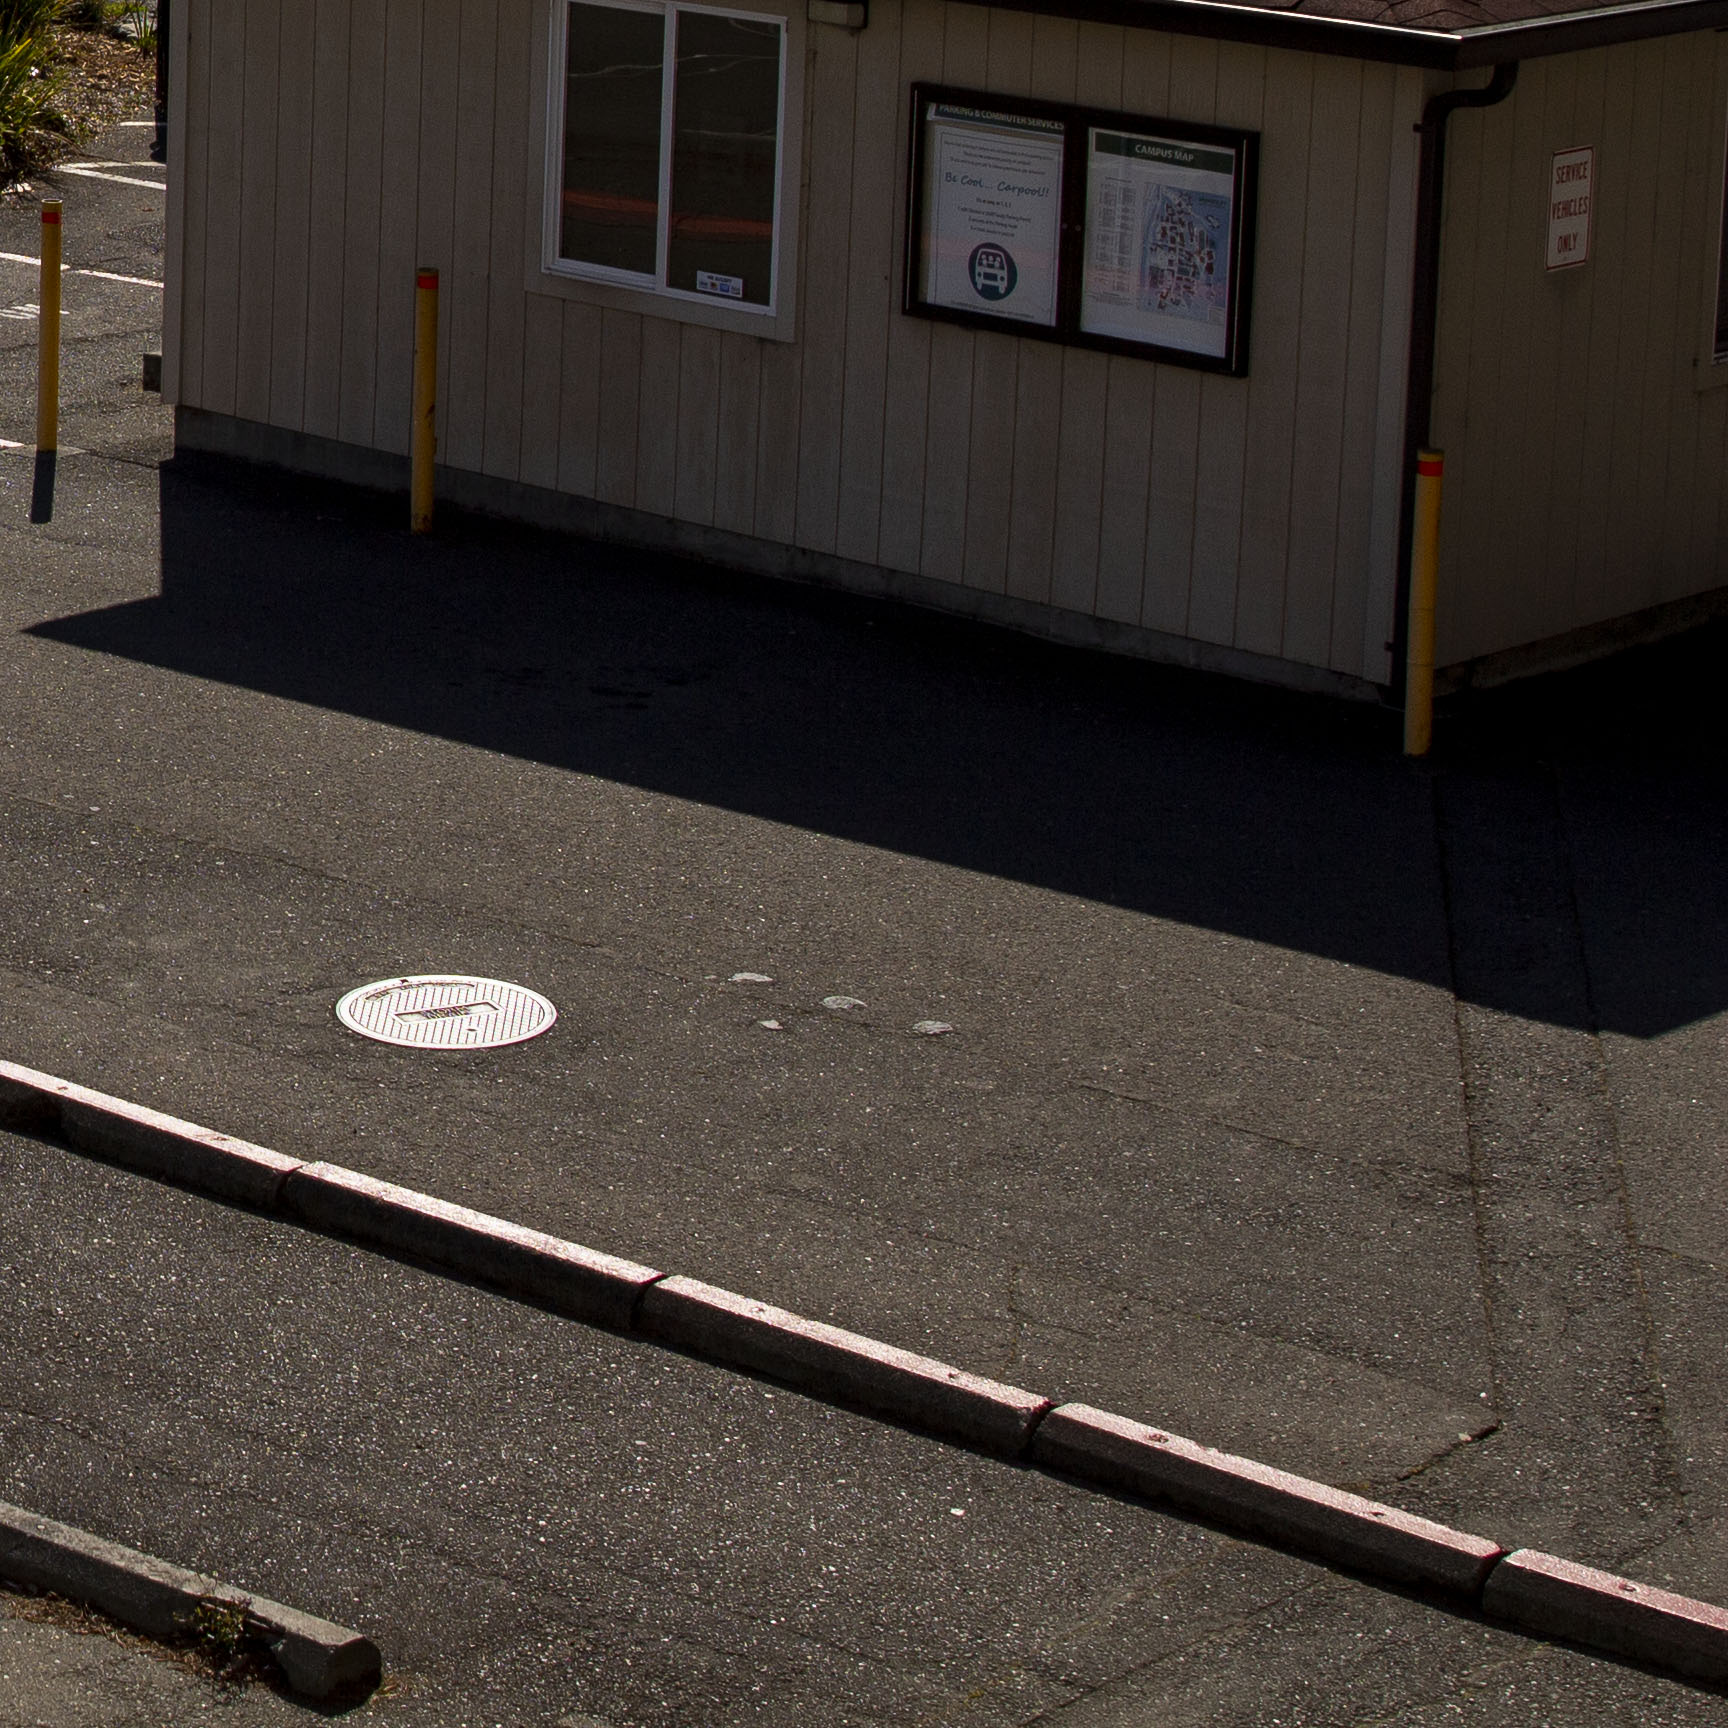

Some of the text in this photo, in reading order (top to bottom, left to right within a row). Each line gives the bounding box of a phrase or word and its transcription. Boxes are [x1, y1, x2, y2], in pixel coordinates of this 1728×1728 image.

[939, 104, 974, 117] PARKING
[981, 110, 1027, 125] COMMUTER
[1027, 116, 1065, 131] SERVICES
[1135, 144, 1194, 163] CAMPUS MAP
[1555, 161, 1588, 185] SERVICE
[1552, 196, 1589, 220] VEHICLES
[1557, 231, 1578, 254] ONLY
